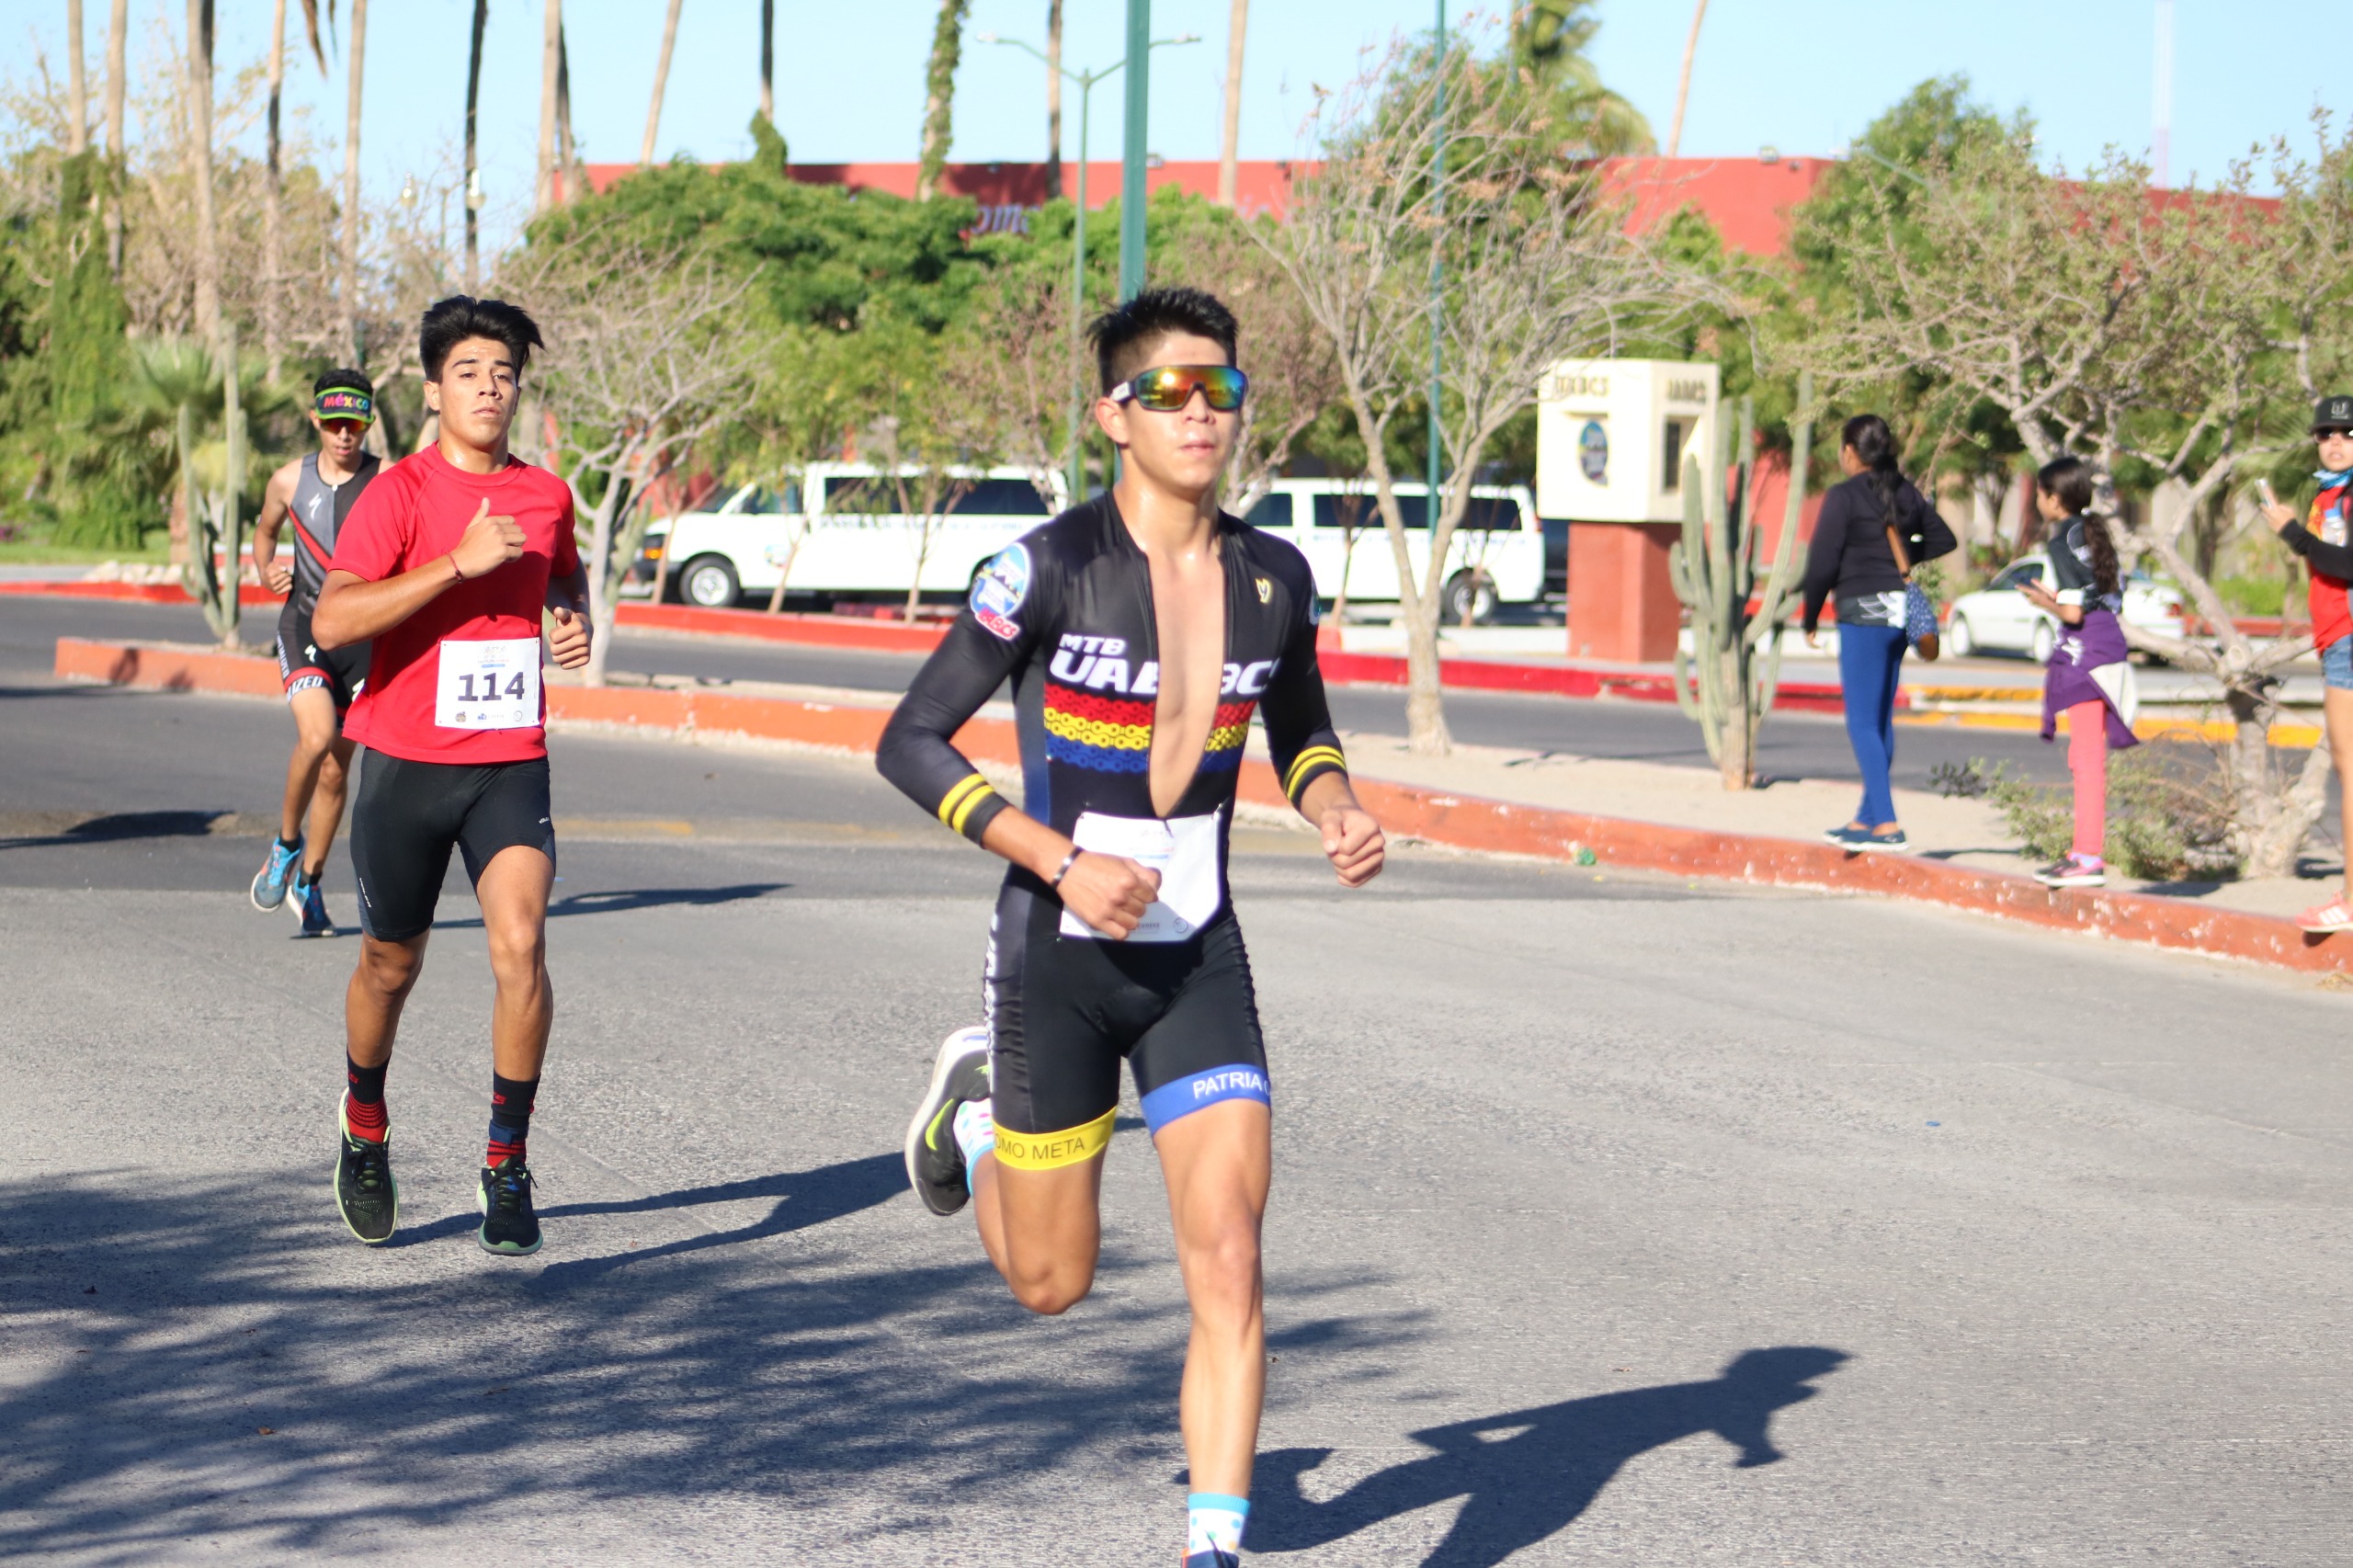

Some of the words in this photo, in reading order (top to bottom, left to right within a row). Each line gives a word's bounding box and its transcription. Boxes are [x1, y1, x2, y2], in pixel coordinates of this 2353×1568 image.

[1059, 634, 1127, 656] MTB
[458, 672, 525, 701] 114
[1193, 1072, 1263, 1099] PATRIA
[995, 1132, 1025, 1159] OMO
[1032, 1136, 1086, 1160] META
